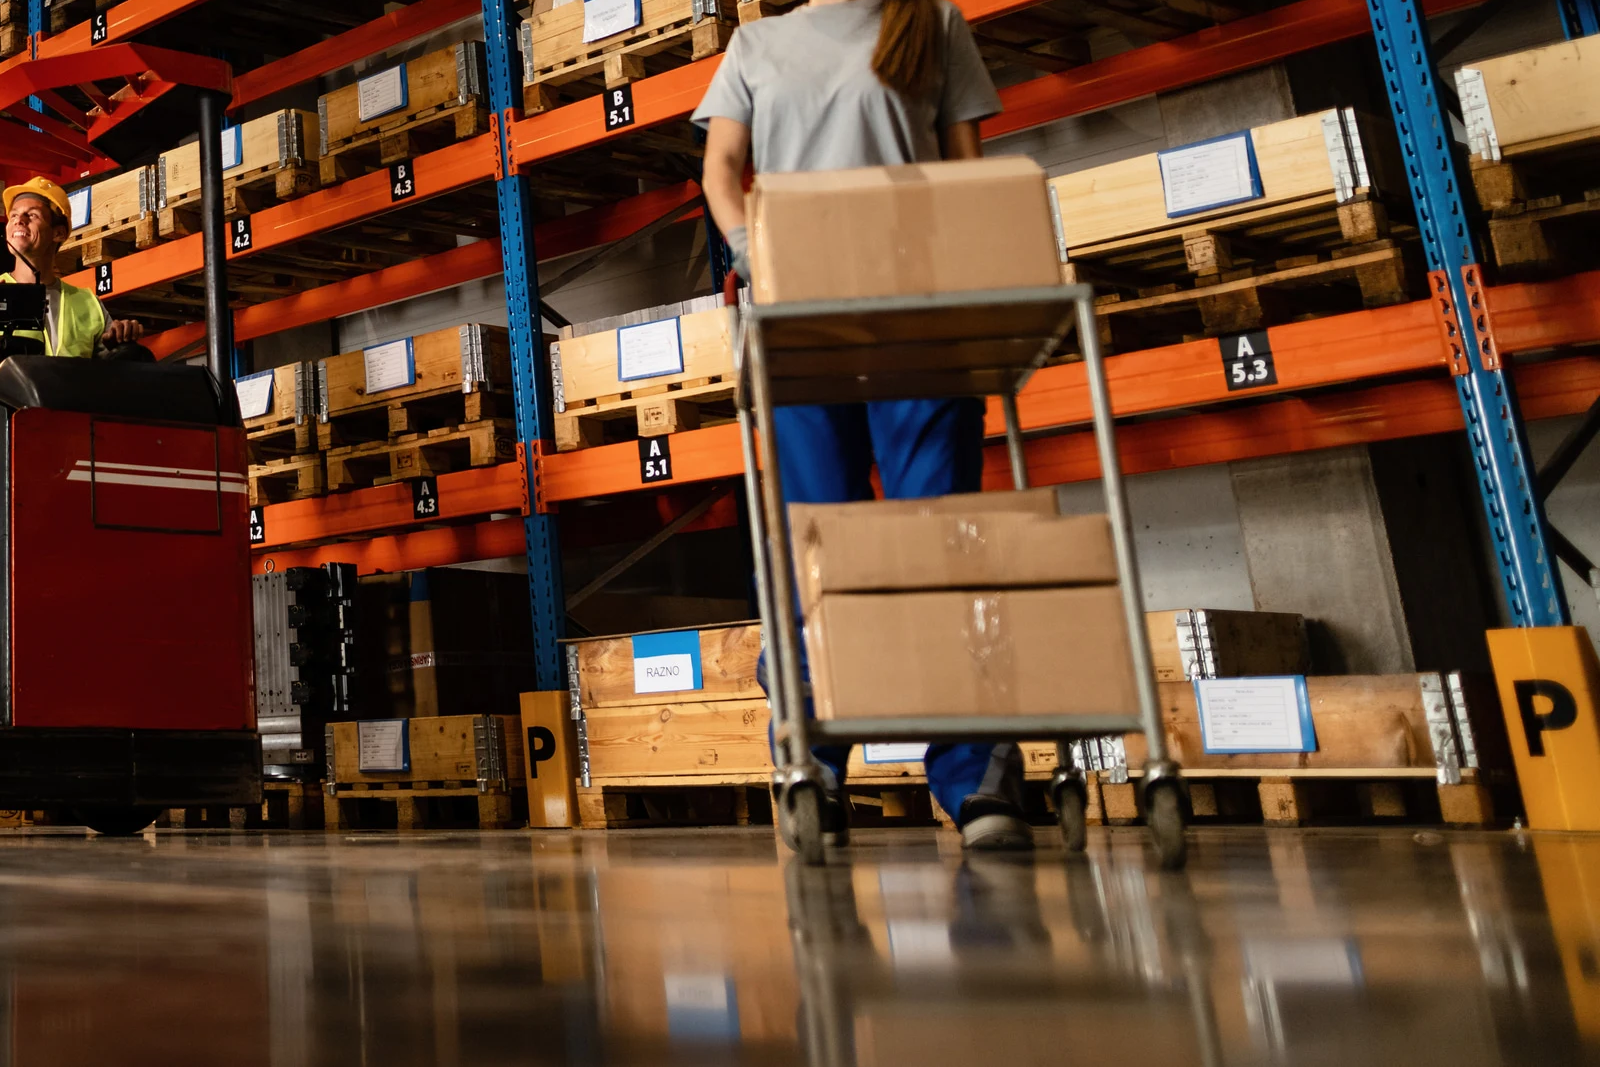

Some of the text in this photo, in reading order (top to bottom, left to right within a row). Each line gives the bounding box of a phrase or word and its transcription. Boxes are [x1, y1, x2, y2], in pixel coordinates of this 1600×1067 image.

[97, 15, 102, 26] C
[94, 27, 105, 40] 4.1
[614, 91, 623, 106] B
[610, 107, 629, 125] 5.1
[398, 165, 405, 178] B
[395, 180, 411, 195] 4.3
[238, 220, 244, 232] B
[235, 234, 249, 248] 4.2
[102, 266, 107, 277] B
[98, 279, 110, 291] 4.1
[1238, 336, 1254, 357] A
[1233, 360, 1267, 383] 5.3
[650, 440, 661, 457] A
[646, 459, 666, 477] 5.1
[421, 481, 429, 495] A
[417, 499, 435, 513] 4.3
[250, 511, 257, 524] A
[646, 666, 680, 678] RAZNO
[1513, 679, 1578, 757] P
[528, 726, 557, 780] P
